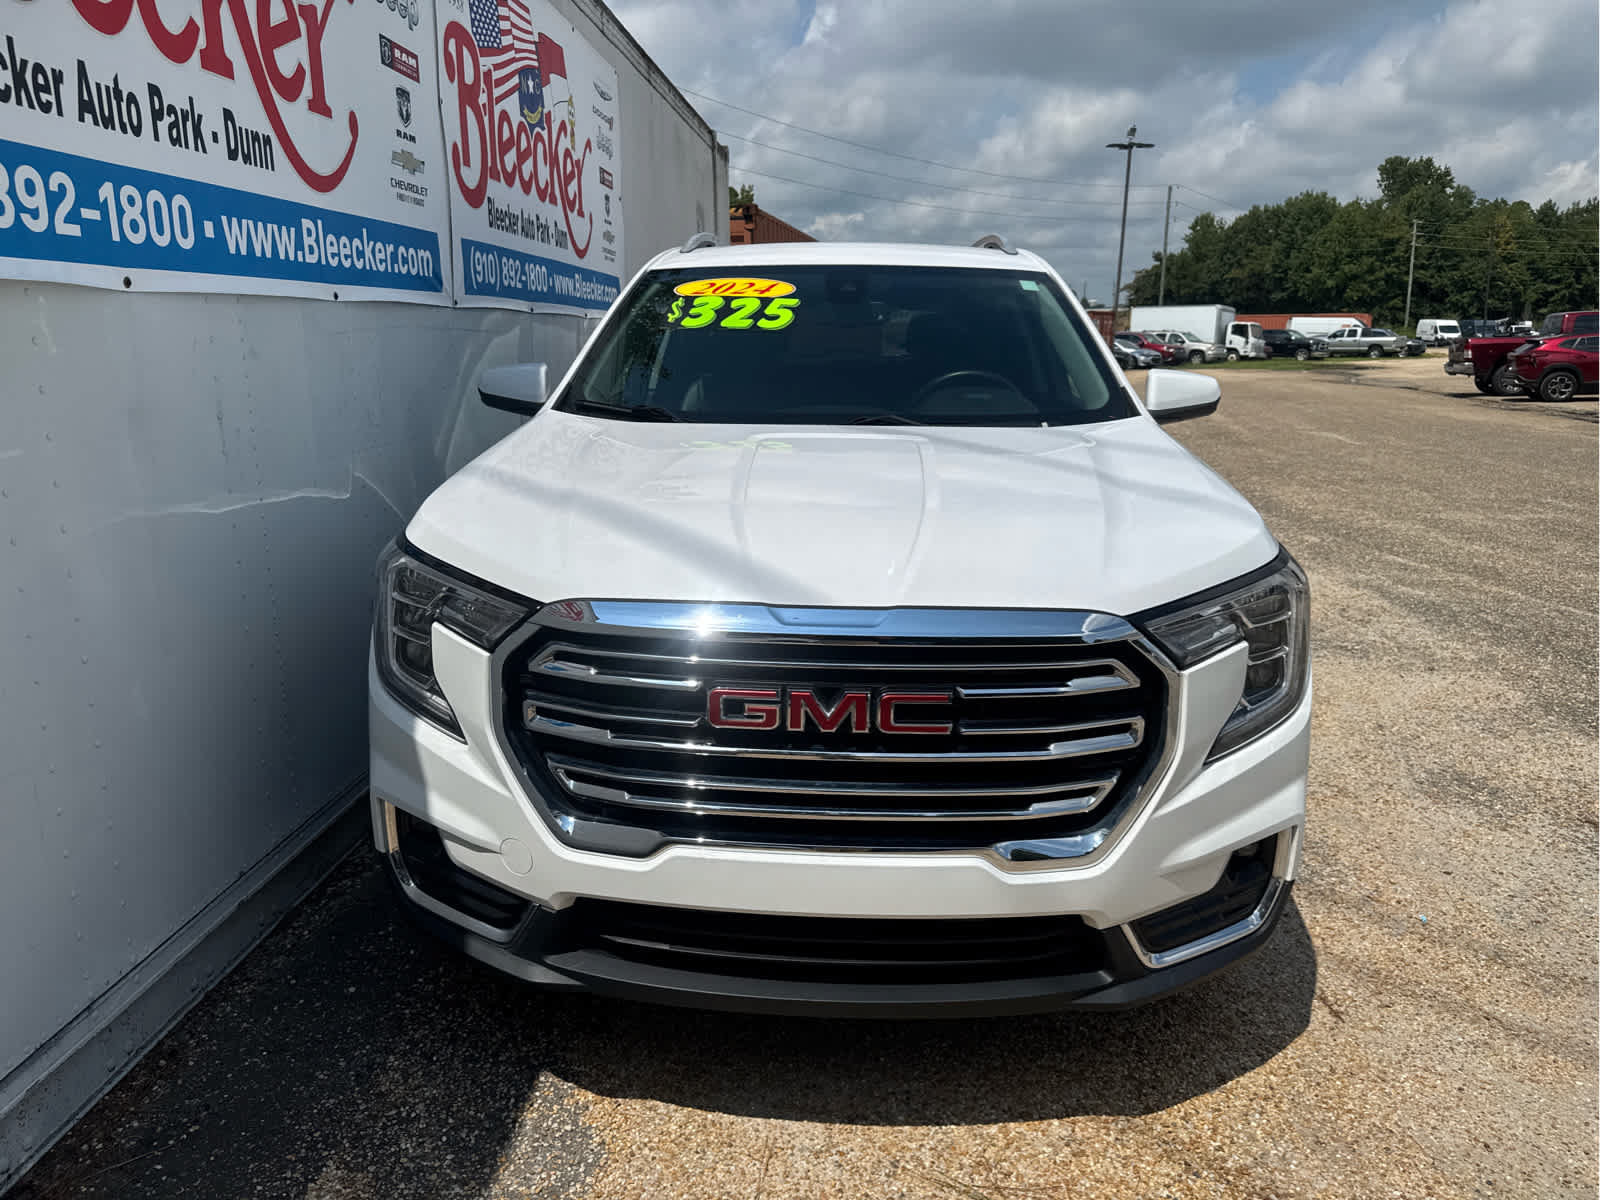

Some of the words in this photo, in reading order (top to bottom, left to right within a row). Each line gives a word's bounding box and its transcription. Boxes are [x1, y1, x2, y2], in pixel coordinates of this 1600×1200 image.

[77, 58, 142, 138] Auto
[147, 82, 207, 154] Park
[222, 107, 275, 171] Dunn
[396, 128, 417, 144] RAM
[444, 21, 592, 259] Bleecker
[390, 177, 428, 197] CHEVROLET
[487, 196, 519, 237] Bleecker
[520, 208, 536, 241] Auto
[536, 213, 551, 246] Park
[221, 215, 433, 278] www.Bleecker.com
[470, 246, 500, 292] (910)
[502, 256, 548, 293] 892-1800
[553, 272, 618, 302] www.Bleecker.com
[691, 282, 779, 294] 2024
[667, 295, 801, 330] $325
[707, 687, 953, 734] GMC
